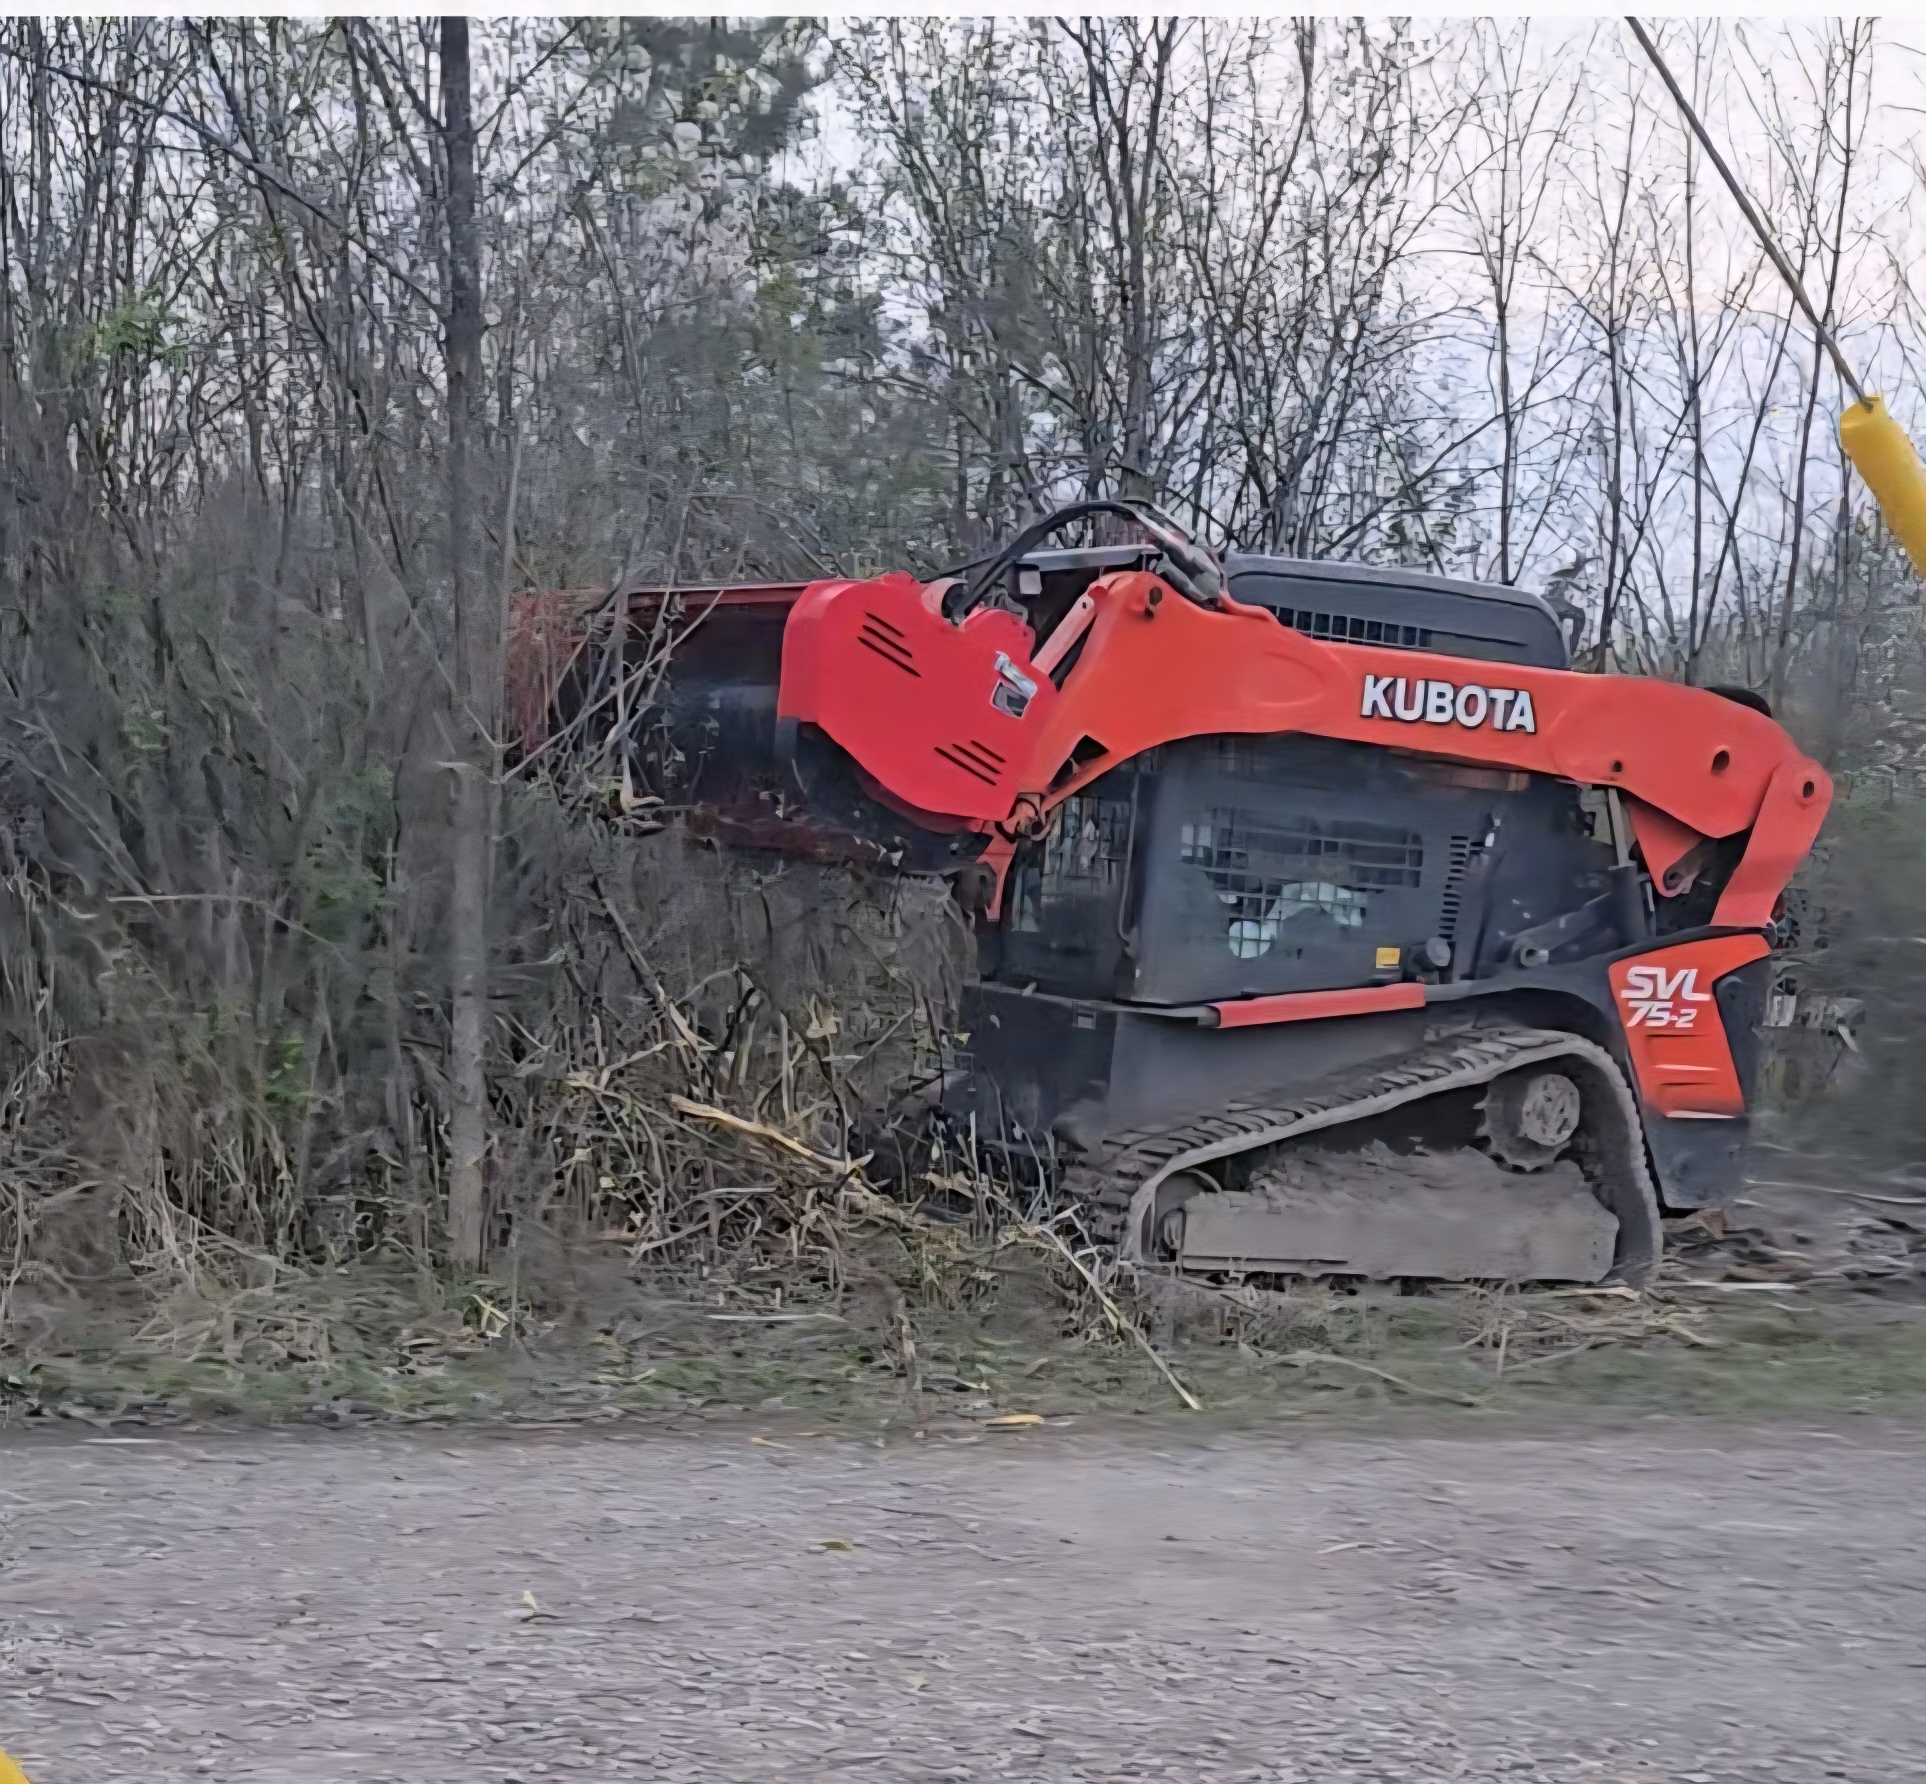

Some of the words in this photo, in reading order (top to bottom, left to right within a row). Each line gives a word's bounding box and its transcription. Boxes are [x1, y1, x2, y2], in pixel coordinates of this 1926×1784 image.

[1361, 674, 1536, 734] KUBOTA
[1620, 965, 1712, 1001] SVL
[1626, 1000, 1698, 1028] 75-2
